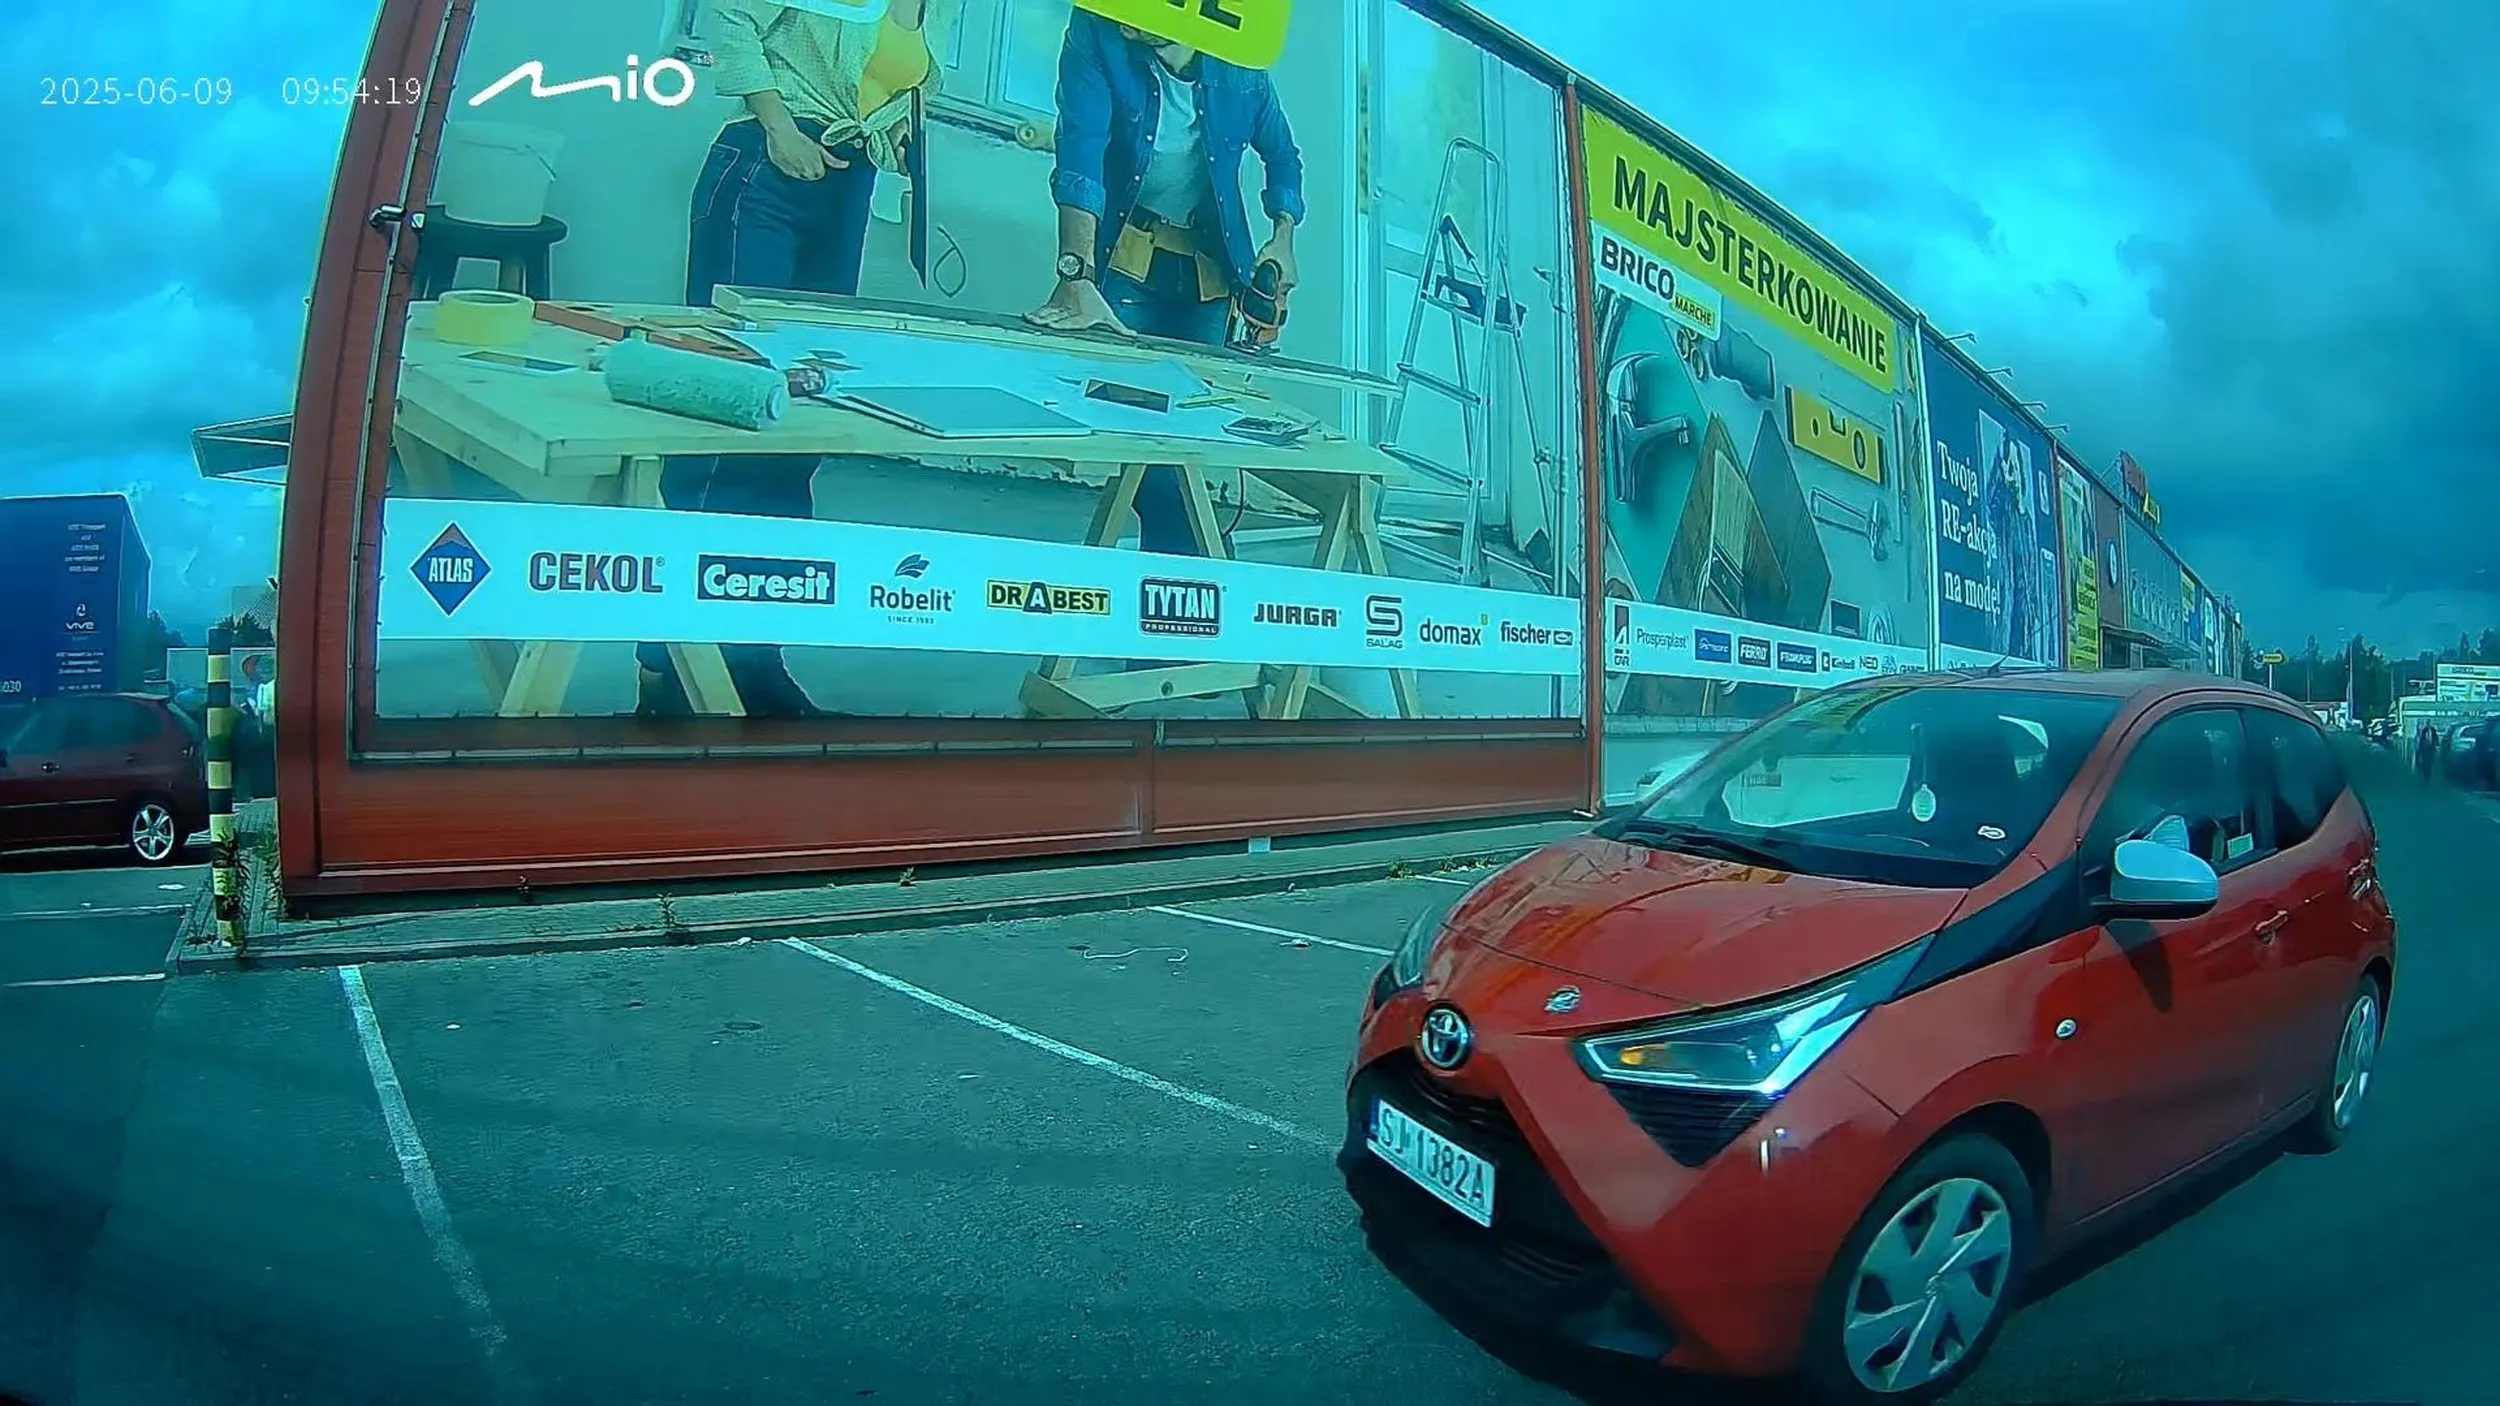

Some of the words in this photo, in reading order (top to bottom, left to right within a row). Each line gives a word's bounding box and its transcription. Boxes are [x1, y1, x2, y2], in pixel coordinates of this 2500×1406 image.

[1601, 236, 1675, 299] BRICO
[1613, 155, 1887, 373] MAJSTERKOWANIE
[1937, 440, 1979, 506] Twoja
[1941, 499, 1998, 569] RE-akcja
[428, 556, 474, 584] ATLAS
[703, 562, 830, 601] Ceresit
[1944, 572, 1962, 603] na
[870, 585, 952, 612] Robelit
[1145, 584, 1215, 620] TYTAN
[1253, 602, 1338, 628] JURGA
[1420, 618, 1481, 646] domax
[1500, 621, 1552, 645] fischer
[1416, 1129, 1486, 1210] 1382A
